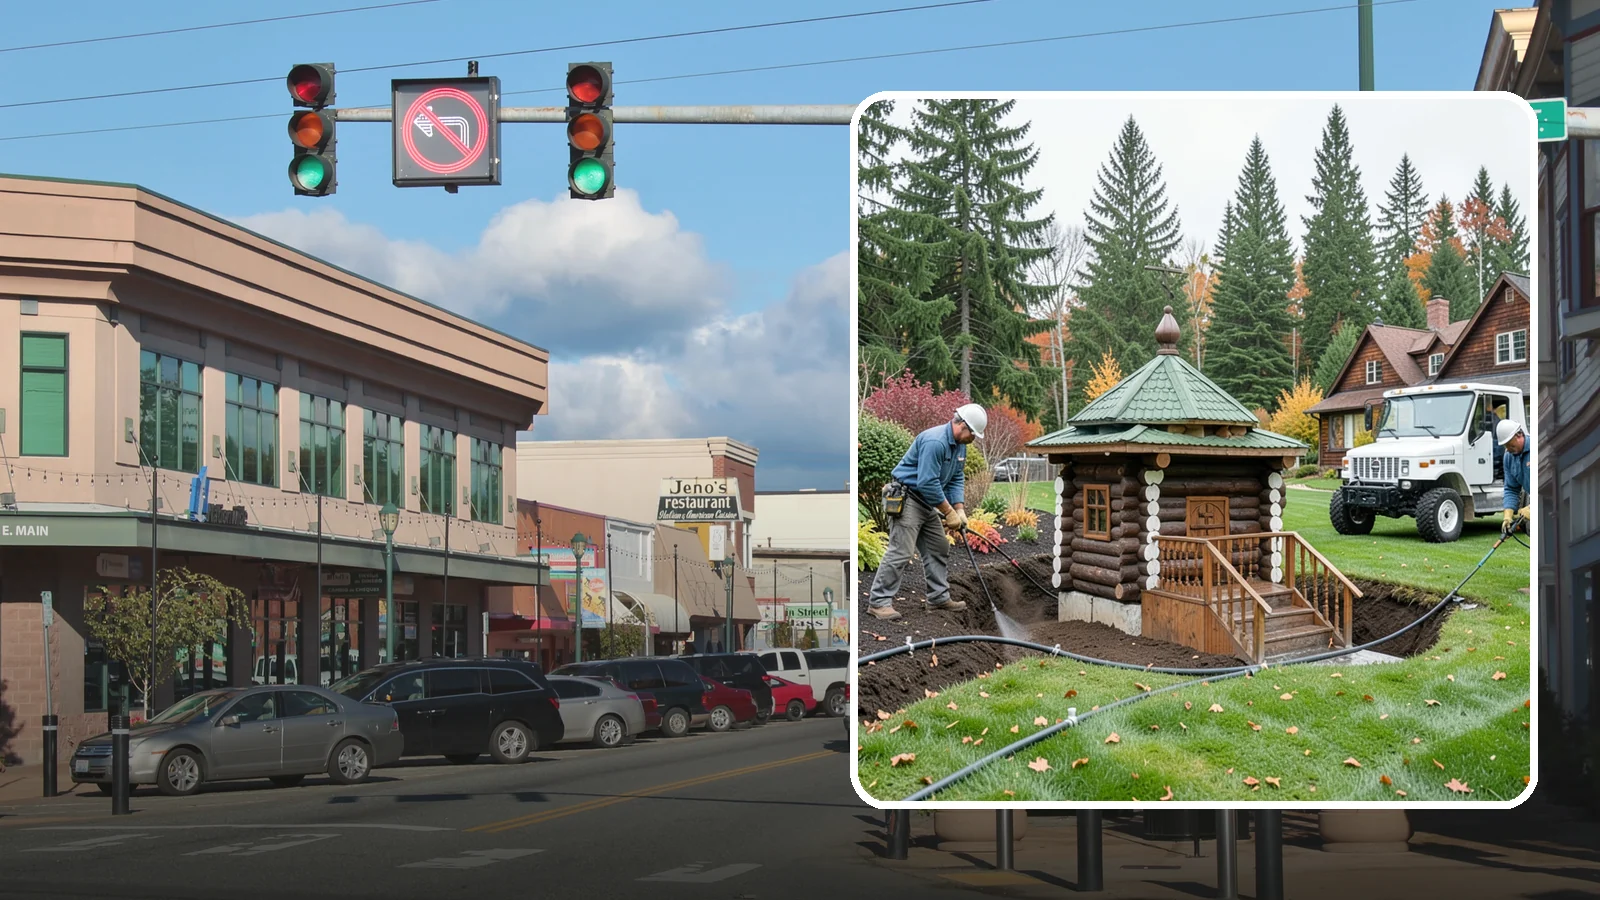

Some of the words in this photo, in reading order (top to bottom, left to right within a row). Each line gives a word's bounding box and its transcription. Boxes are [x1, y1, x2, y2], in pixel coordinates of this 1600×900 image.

[670, 480, 727, 494] Jeno's
[665, 496, 731, 509] restaurant
[658, 510, 680, 519] Italian
[686, 510, 714, 519] American
[715, 510, 737, 518] Cuisine
[2, 525, 12, 536] E.
[16, 525, 48, 536] MAIN
[798, 608, 828, 616] Street
